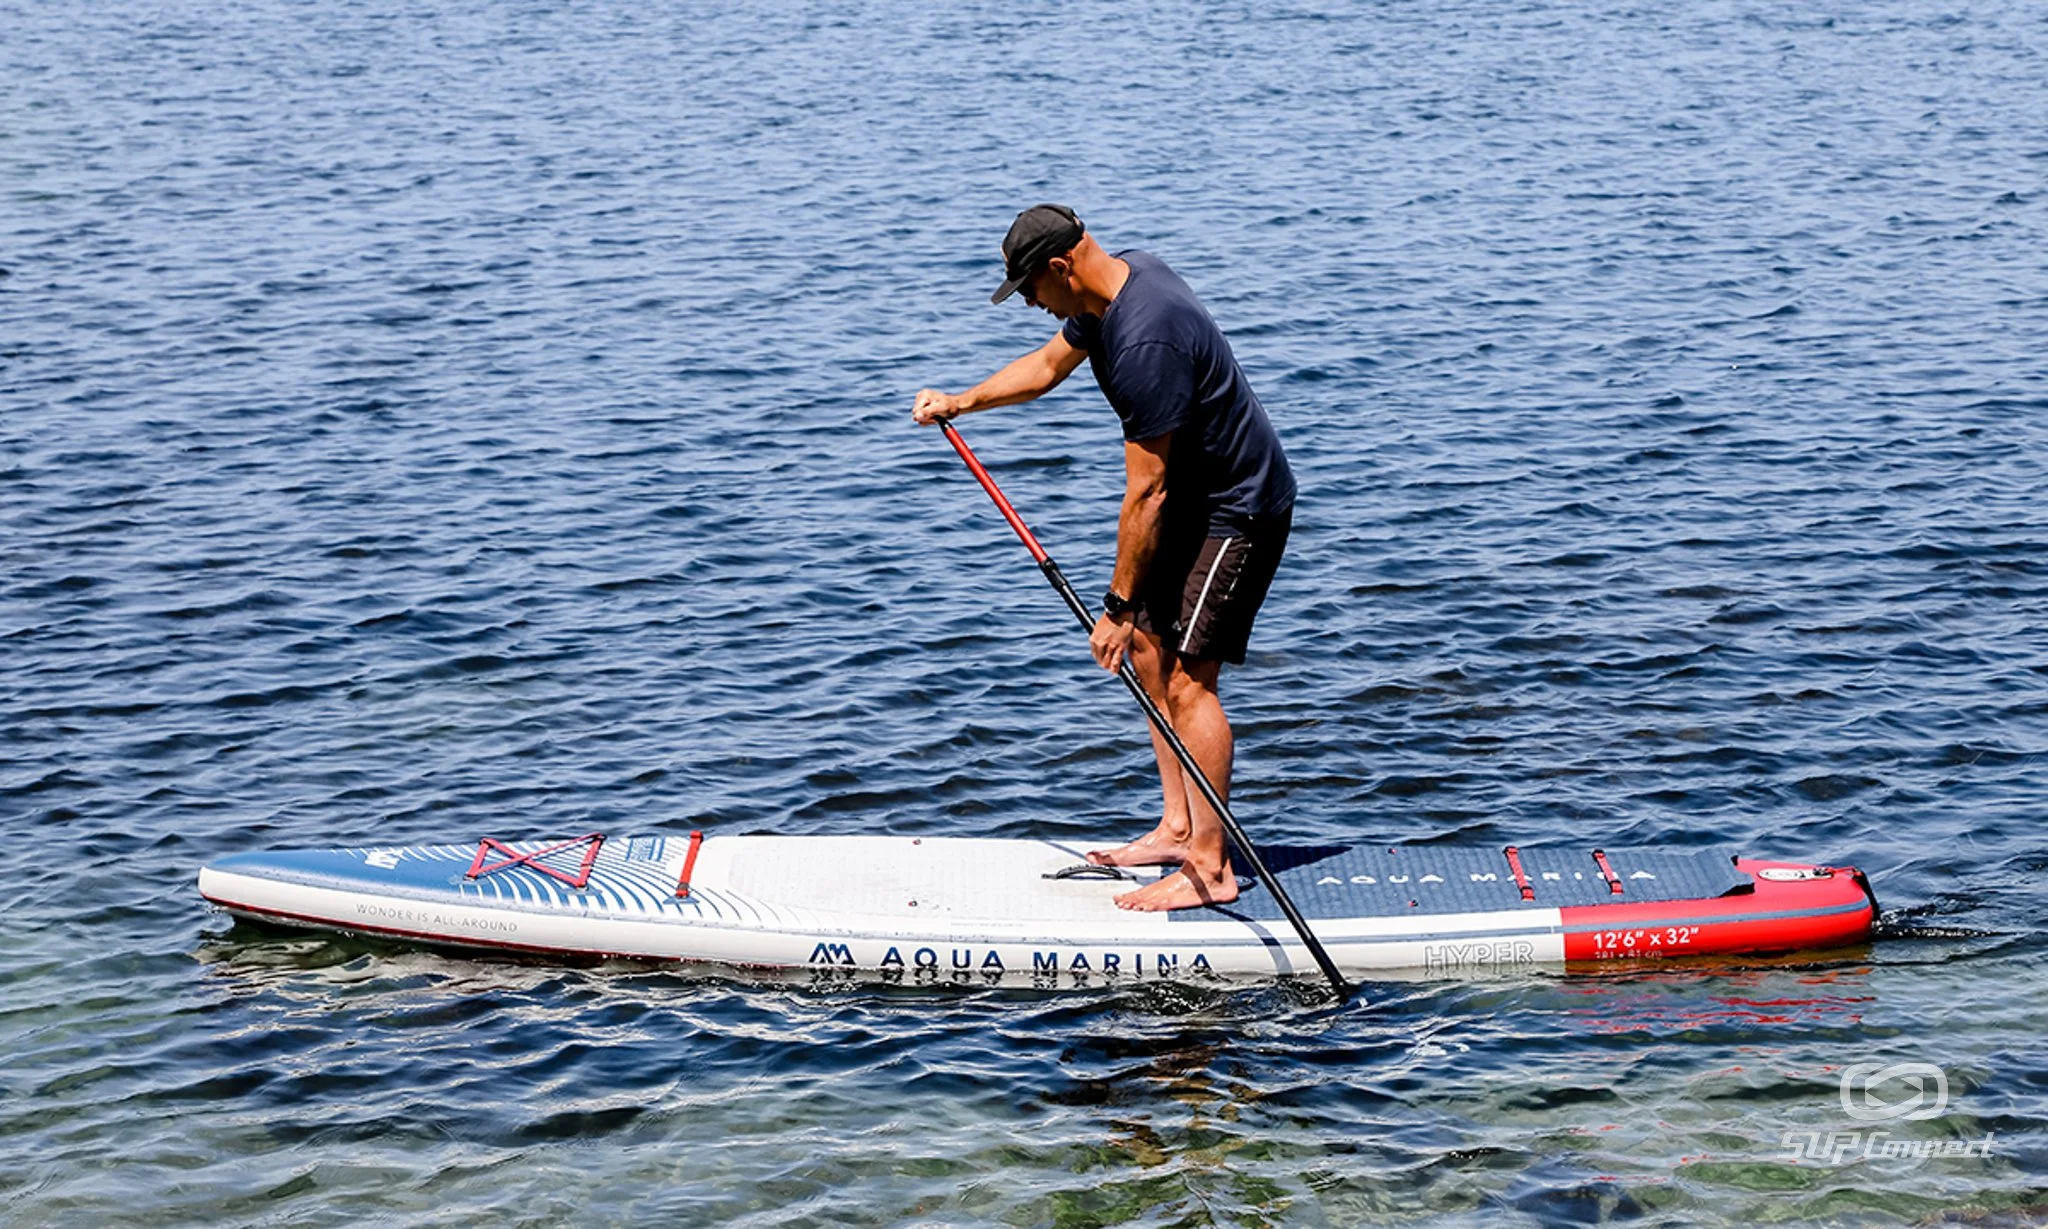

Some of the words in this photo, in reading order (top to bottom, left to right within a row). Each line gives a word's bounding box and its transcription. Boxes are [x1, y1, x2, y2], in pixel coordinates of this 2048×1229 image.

[1316, 873, 1445, 885] AQUA
[356, 903, 413, 921] WONDER
[417, 911, 429, 922] IS
[433, 914, 518, 933] ALL-AROUND
[880, 946, 1006, 971] AQUA
[1032, 951, 1214, 974] MARINA
[1424, 940, 1536, 968] HYPER
